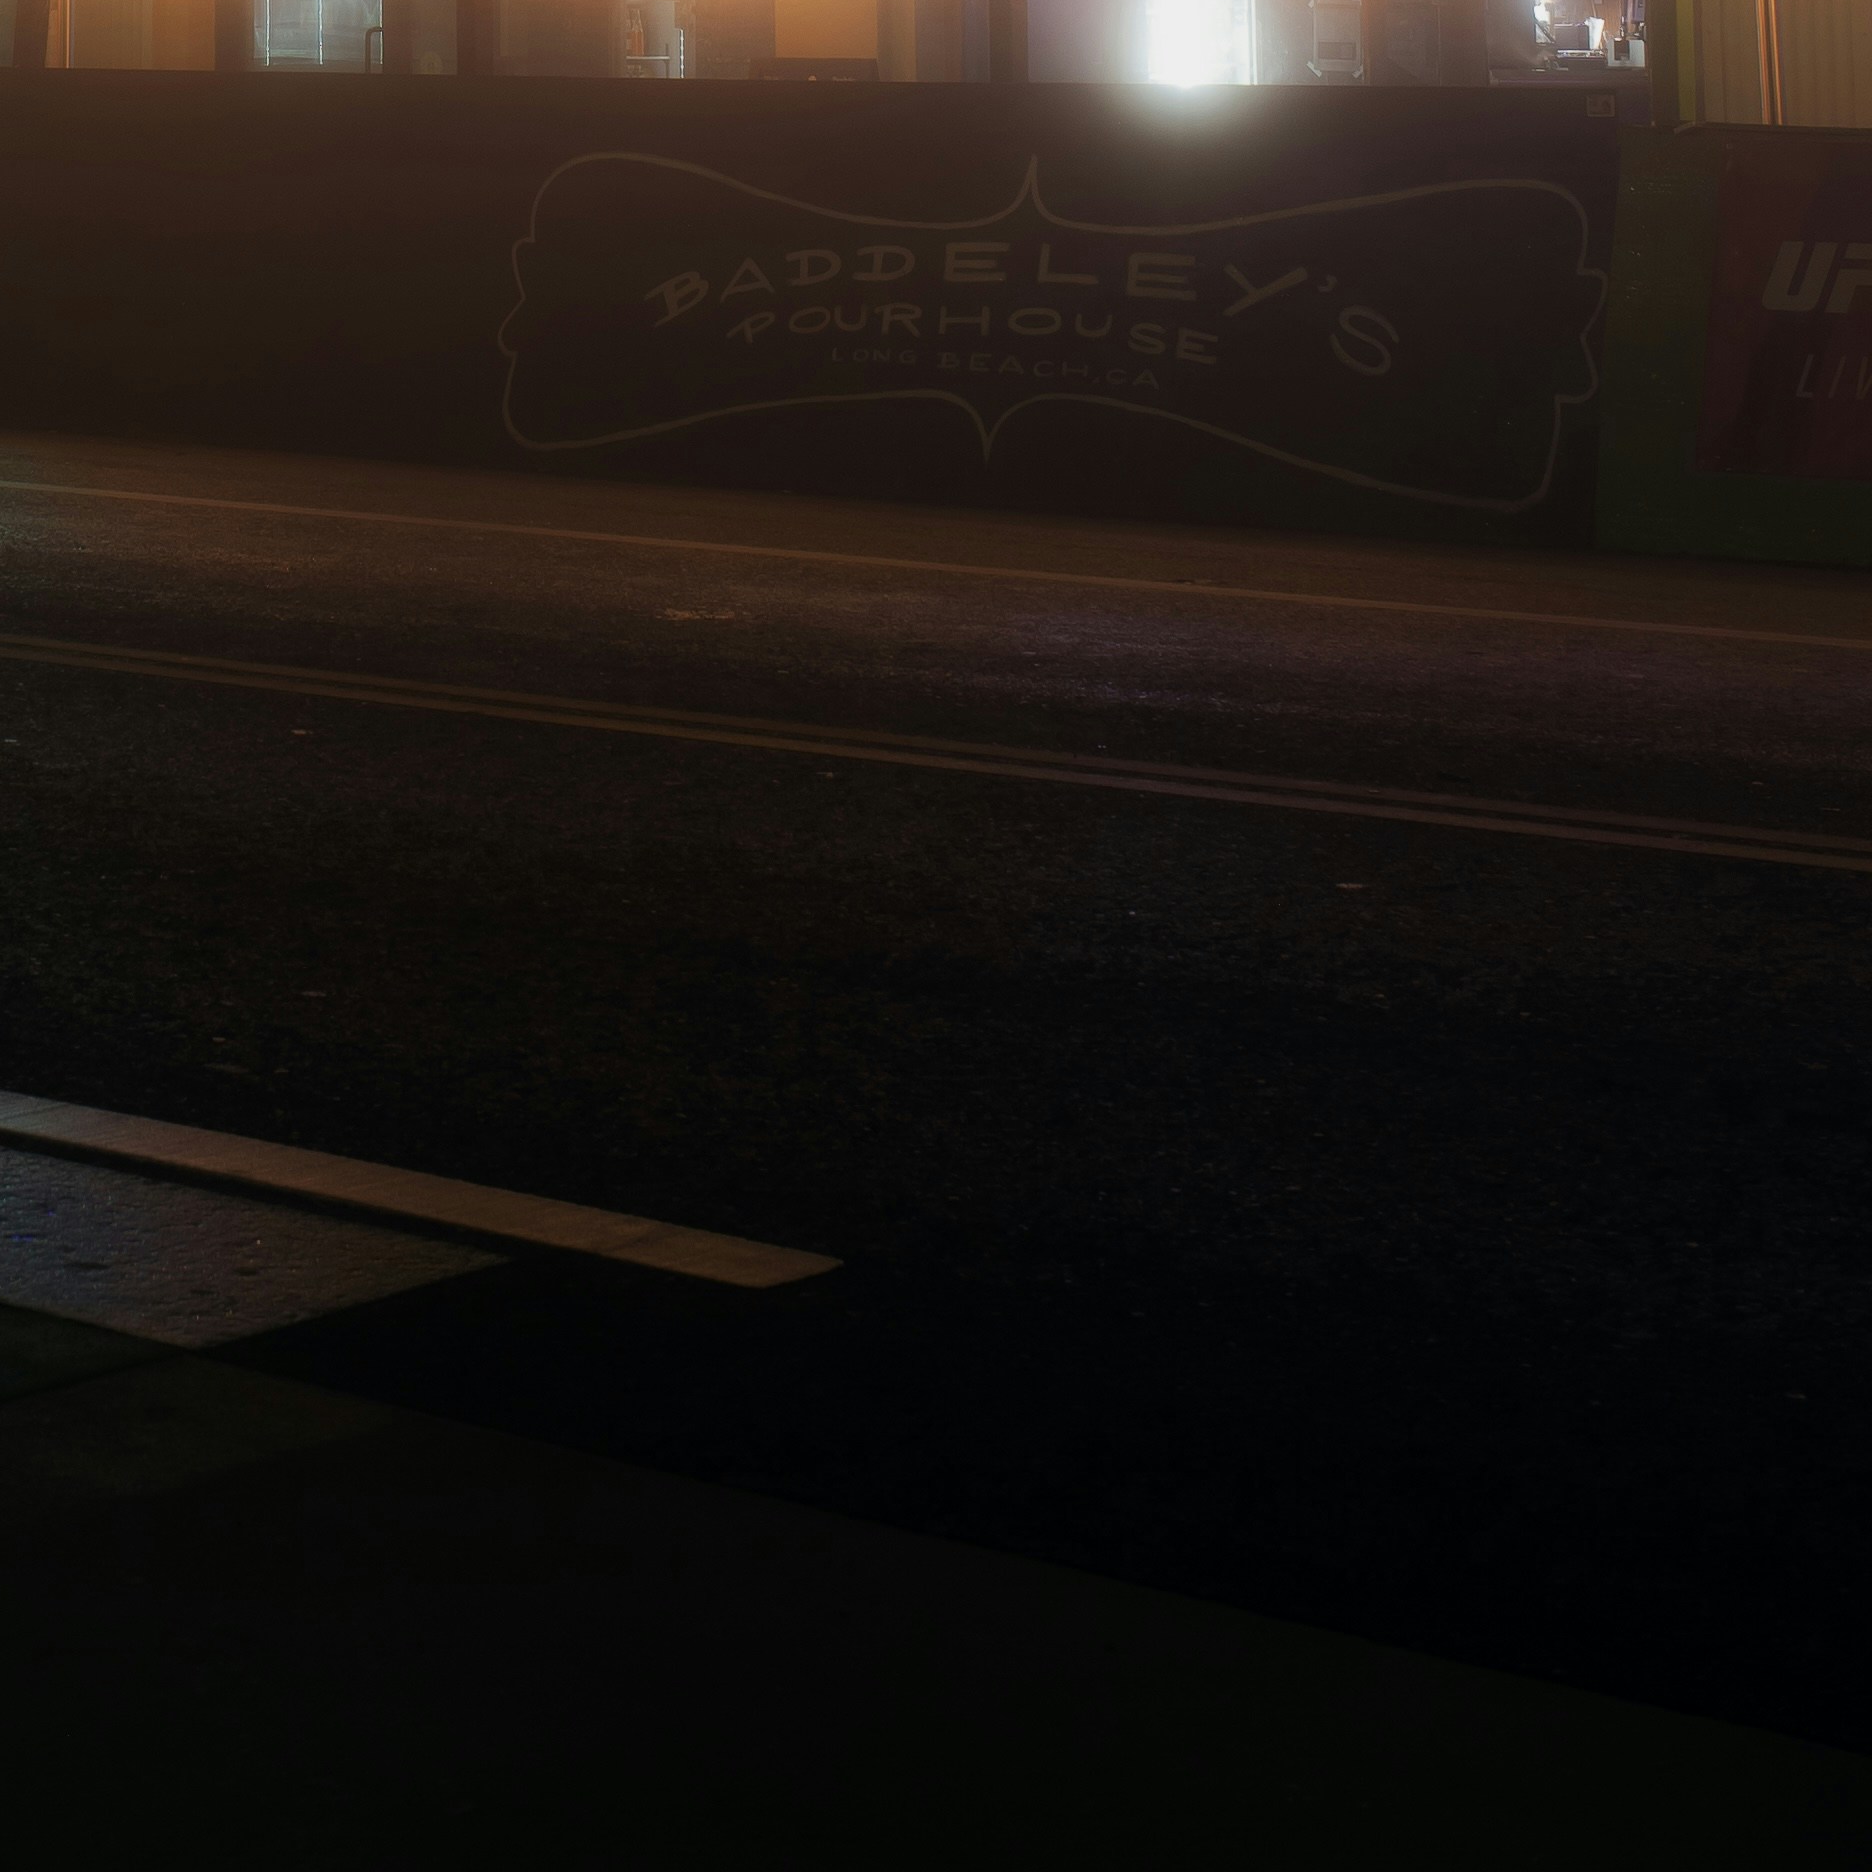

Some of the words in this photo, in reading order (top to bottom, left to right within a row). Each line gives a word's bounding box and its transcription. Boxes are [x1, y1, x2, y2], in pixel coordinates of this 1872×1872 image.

[643, 242, 1400, 376] BADDELEY'S
[728, 304, 1219, 365] POURHOUSE
[832, 346, 918, 365] LONG
